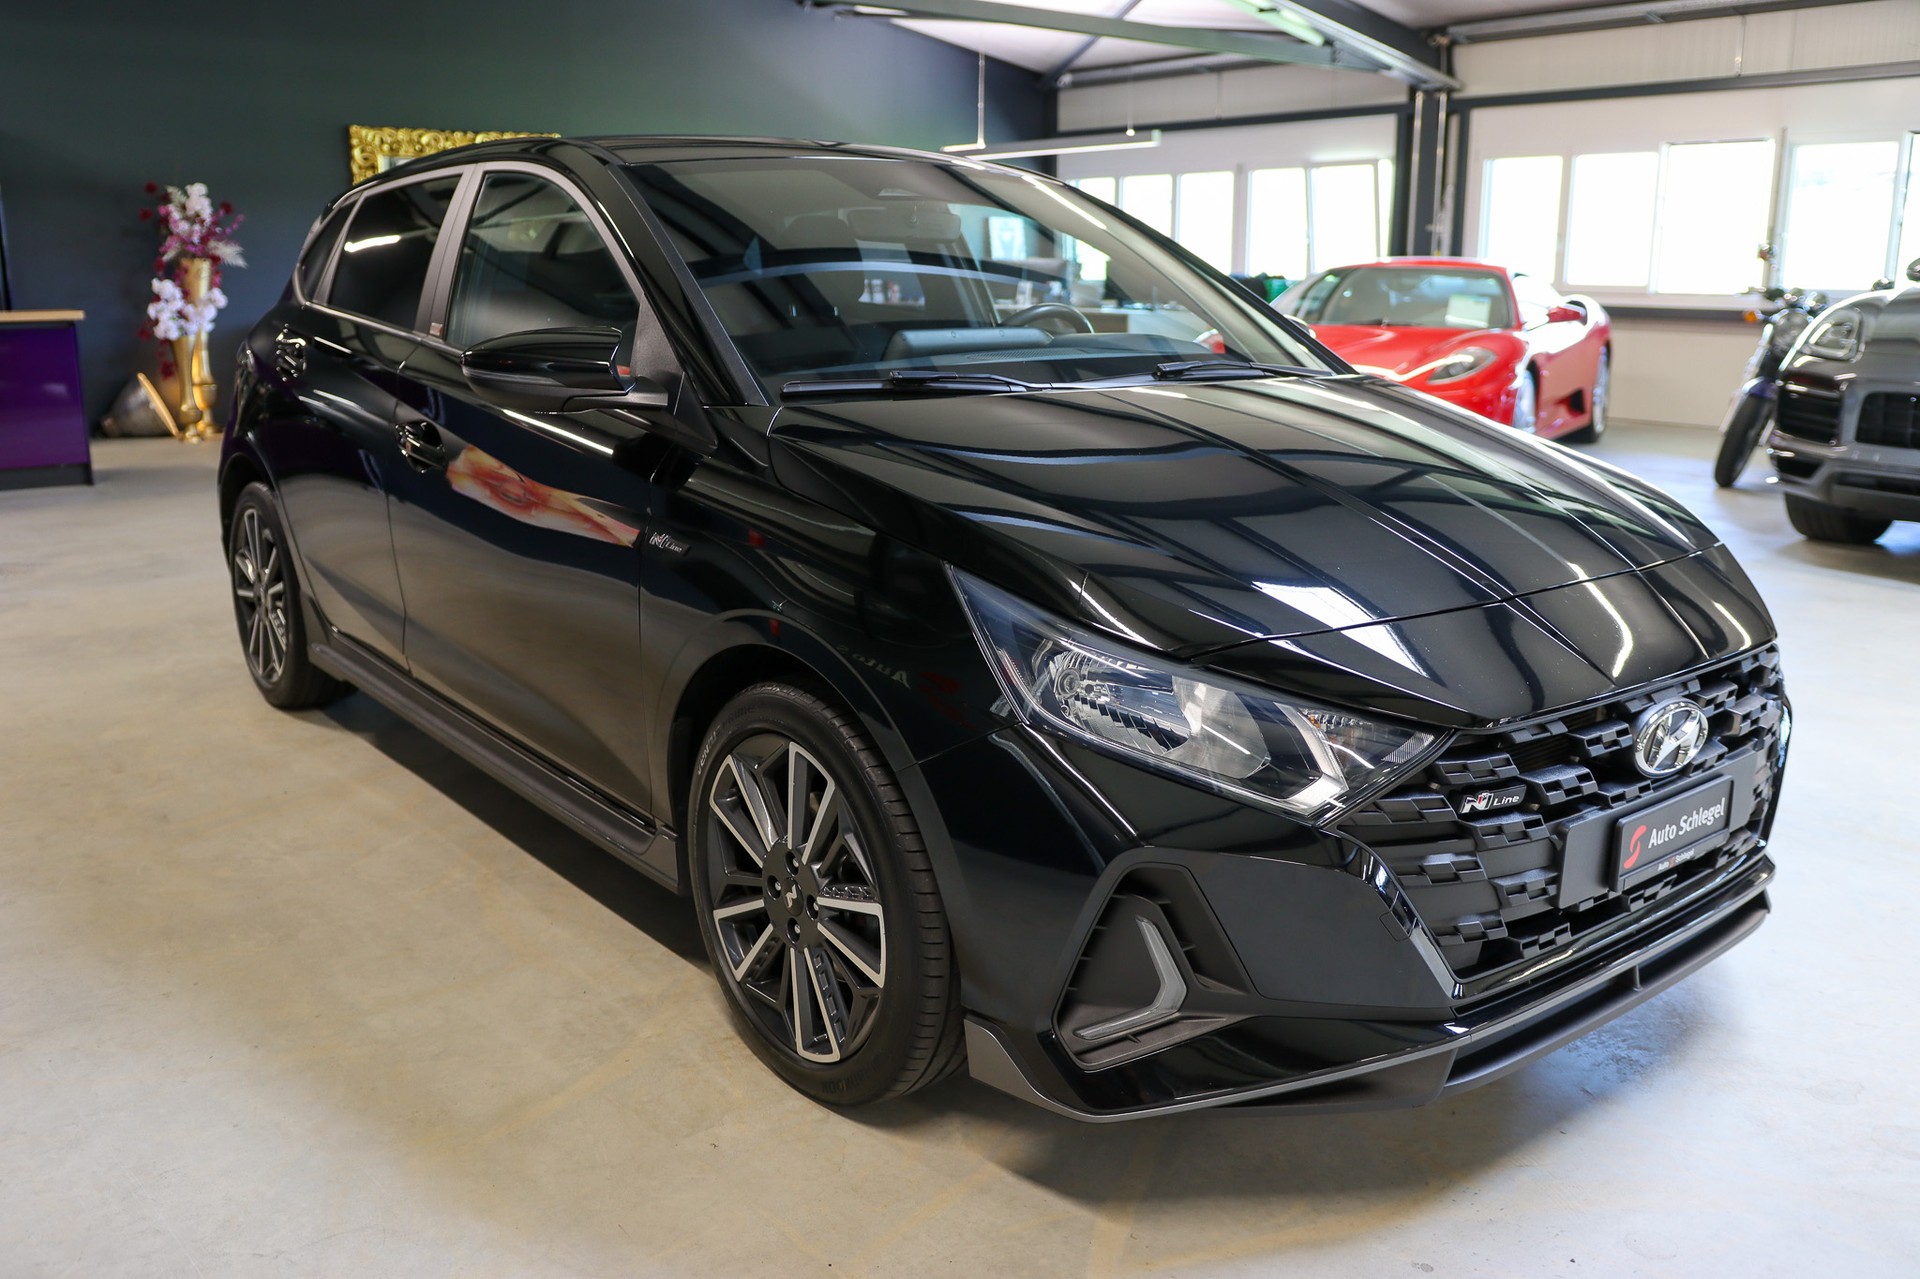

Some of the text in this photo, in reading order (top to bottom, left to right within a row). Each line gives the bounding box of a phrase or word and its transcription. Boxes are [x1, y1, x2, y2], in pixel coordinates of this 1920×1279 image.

[1493, 796, 1519, 807] Line
[1647, 797, 1725, 849] Auto Schlegel
